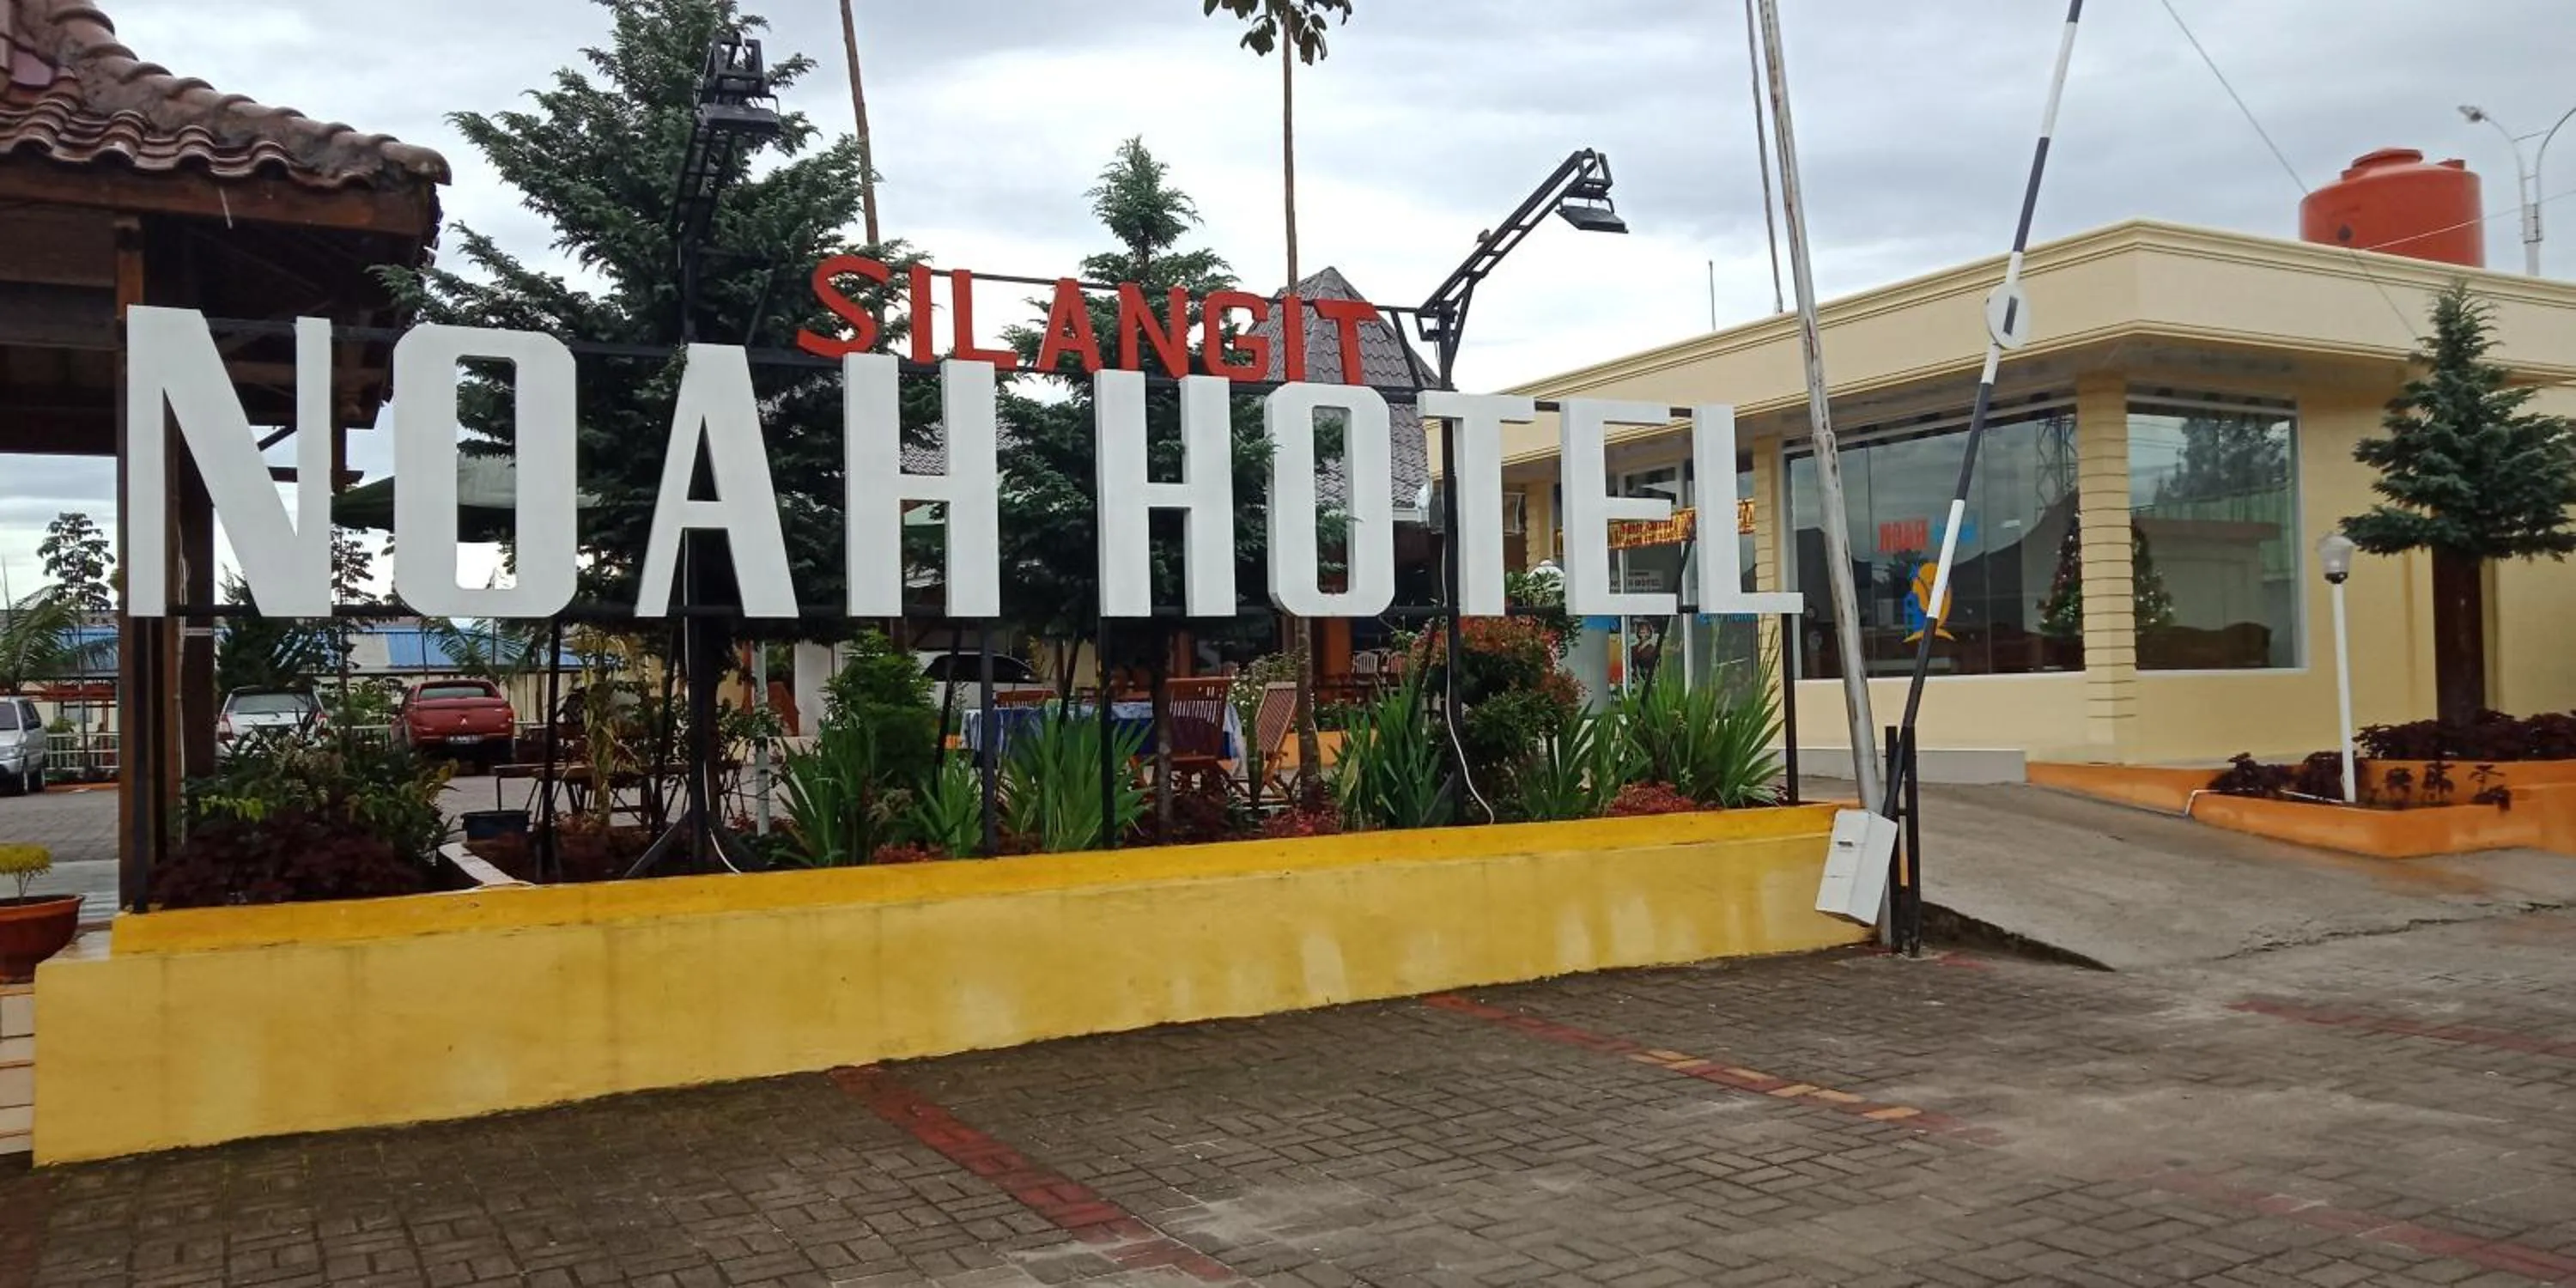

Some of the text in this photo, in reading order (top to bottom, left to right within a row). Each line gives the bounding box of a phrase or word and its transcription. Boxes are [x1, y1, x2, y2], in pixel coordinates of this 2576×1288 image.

[797, 254, 1380, 386] SILANGIT
[126, 306, 1804, 618] NOAH HOTEL
